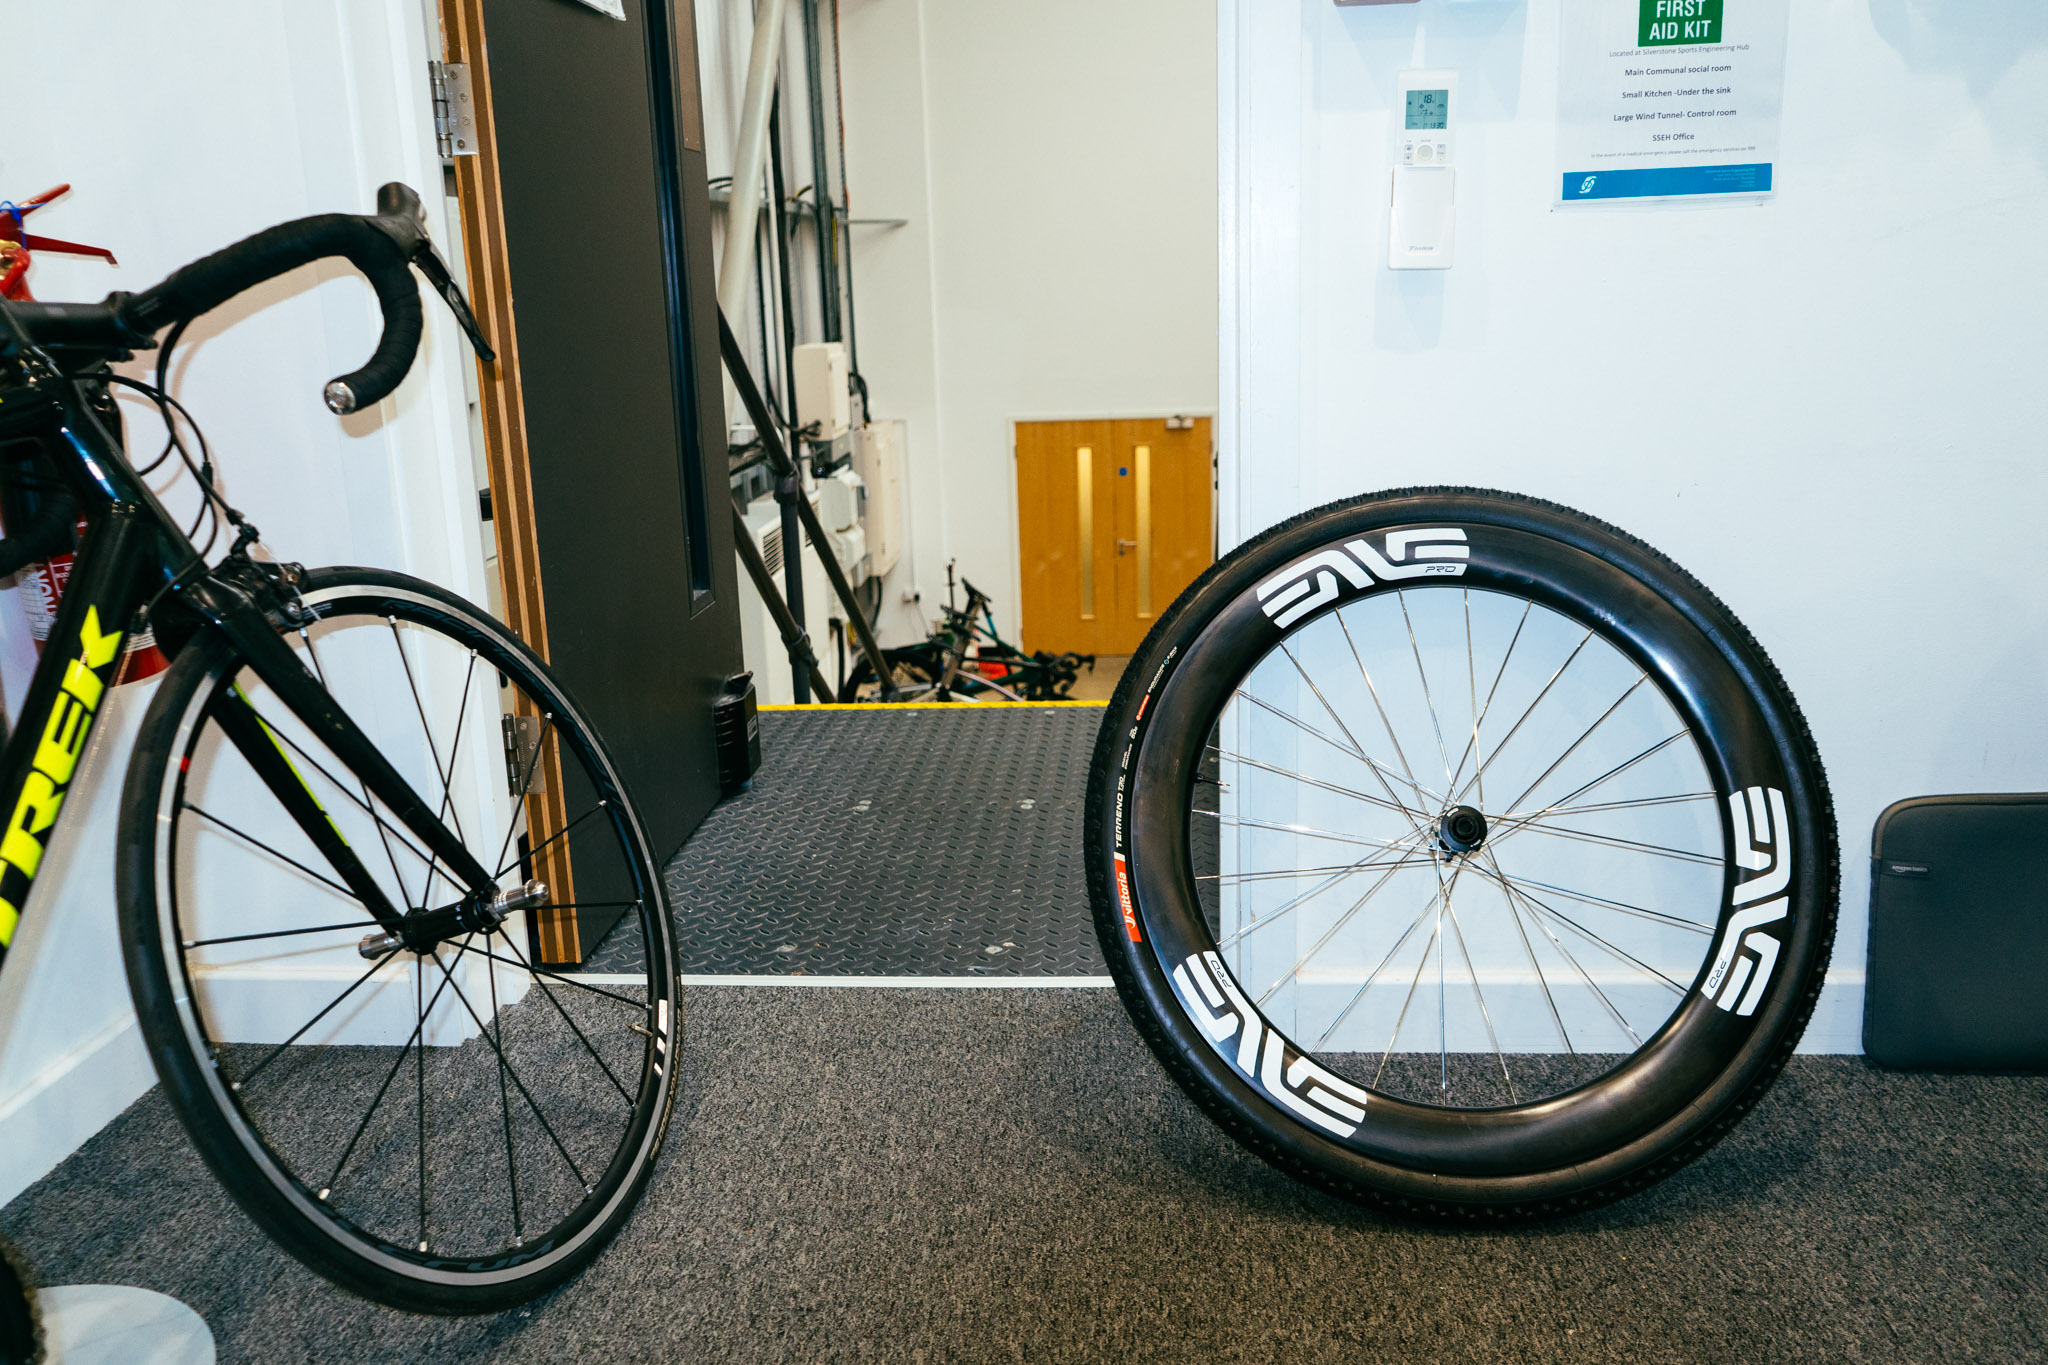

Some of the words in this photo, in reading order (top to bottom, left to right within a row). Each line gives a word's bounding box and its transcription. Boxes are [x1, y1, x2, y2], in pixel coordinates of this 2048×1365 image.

[1657, 0, 1705, 18] FIRST
[1649, 22, 1678, 40] AID
[1684, 20, 1712, 38] KIT
[1609, 49, 1634, 57] Located
[1642, 47, 1676, 56] Silverstone
[1699, 45, 1735, 53] Engineering
[1646, 65, 1687, 75] Communal
[1688, 65, 1710, 73] social
[1423, 94, 1433, 104] 18
[1621, 90, 1643, 99] Small
[1644, 89, 1672, 98] Kitchen
[1673, 88, 1700, 96] -Under
[1702, 87, 1715, 95] the
[1716, 86, 1732, 94] sink
[1613, 114, 1634, 122] Large
[1635, 112, 1656, 120] Wind
[1657, 110, 1685, 119] Tunnel-
[1686, 109, 1715, 118] Control
[1652, 134, 1671, 142] SSEH
[1425, 565, 1456, 573] PRO
[1256, 527, 1470, 630] ENVE
[1115, 792, 1124, 848] TERRENO
[1118, 872, 1133, 916] vittoria
[1210, 959, 1232, 988] PRO
[1708, 958, 1727, 989] PRO
